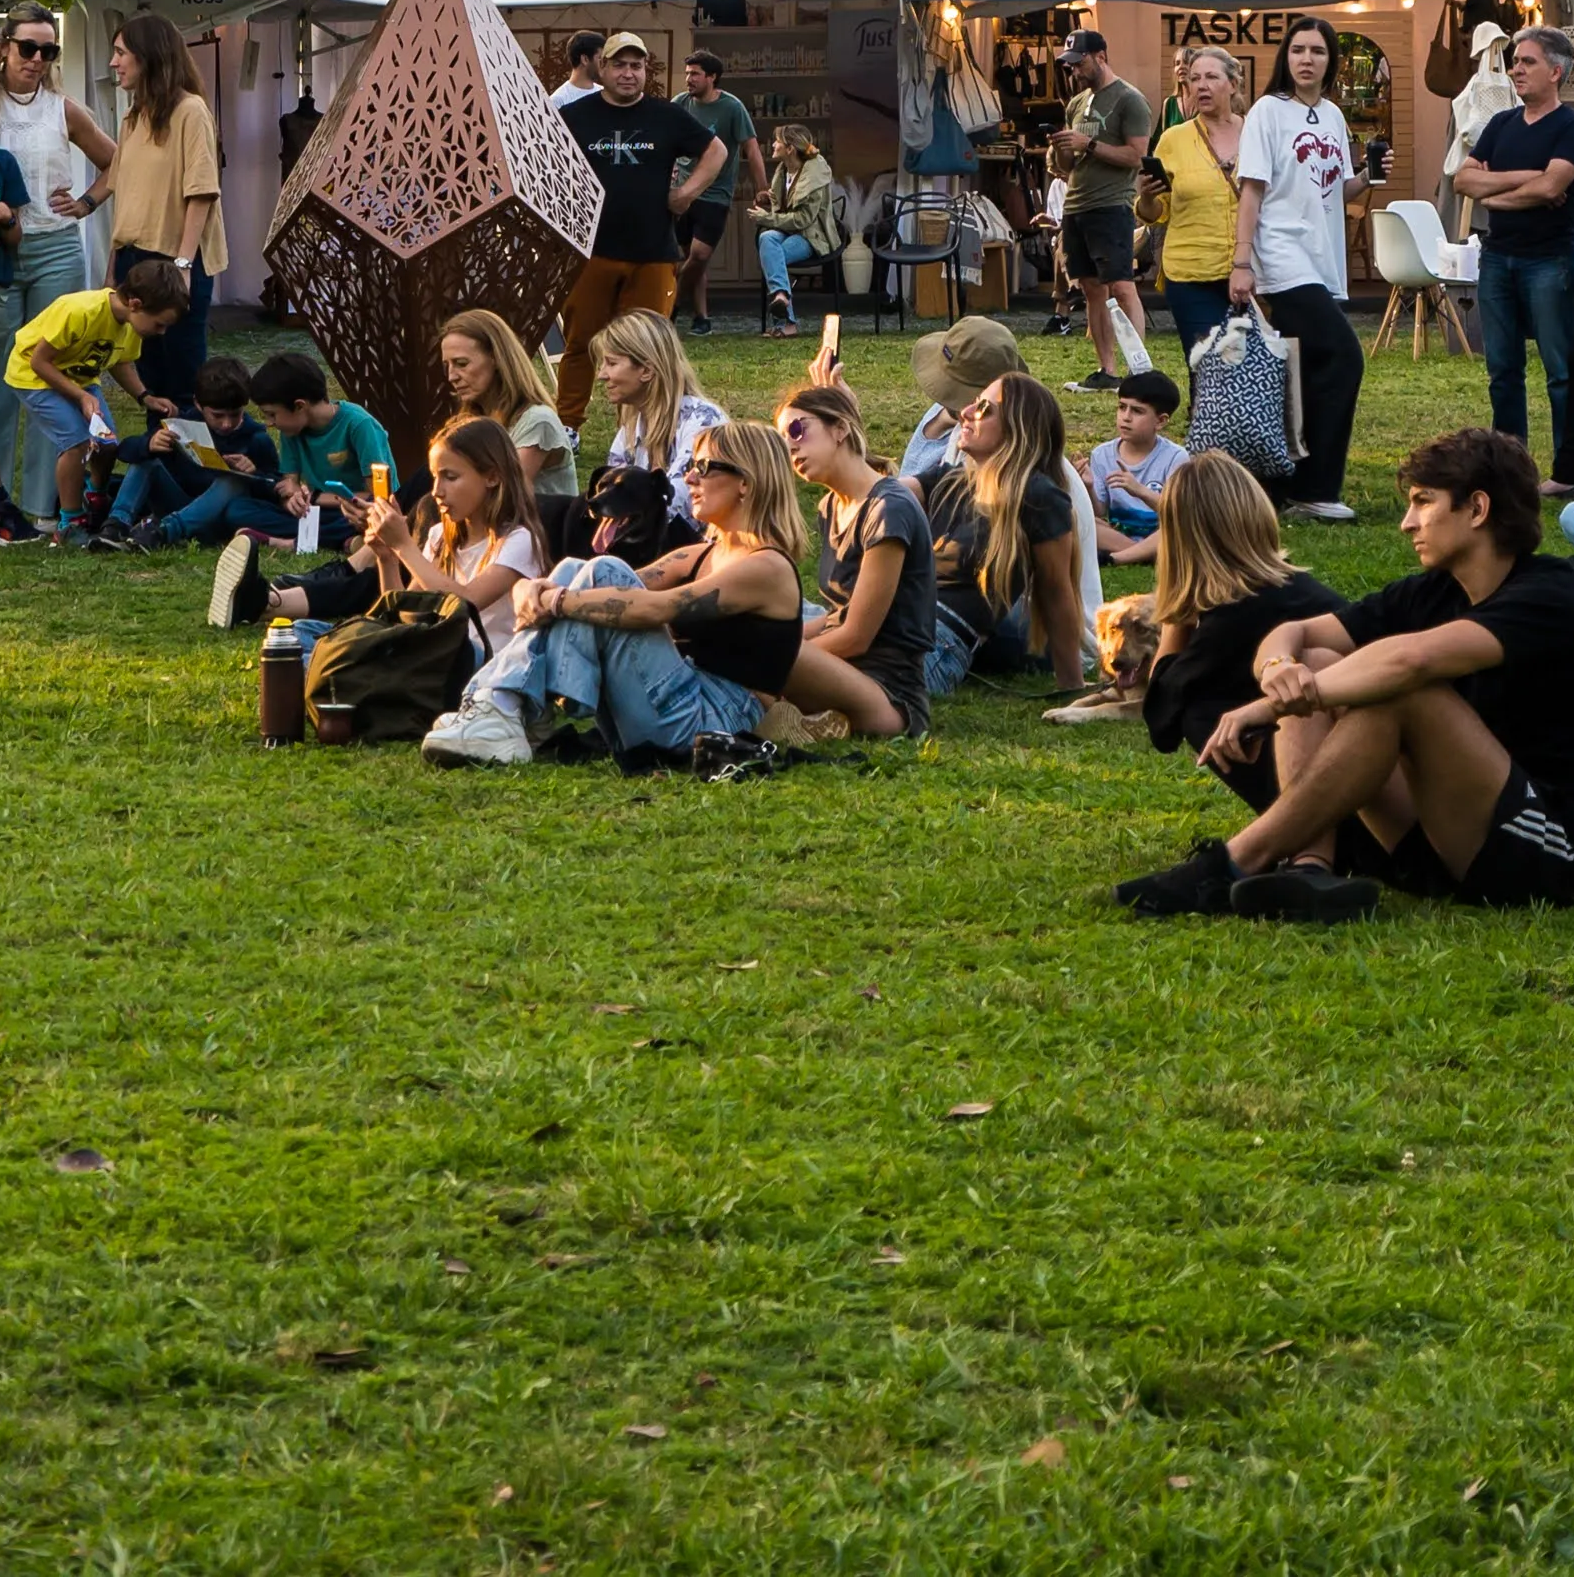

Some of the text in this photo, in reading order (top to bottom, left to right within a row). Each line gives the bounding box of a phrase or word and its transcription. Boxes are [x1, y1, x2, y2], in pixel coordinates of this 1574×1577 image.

[856, 27, 893, 57] Just
[588, 142, 654, 151] CALVIN KLEIN JEANS
